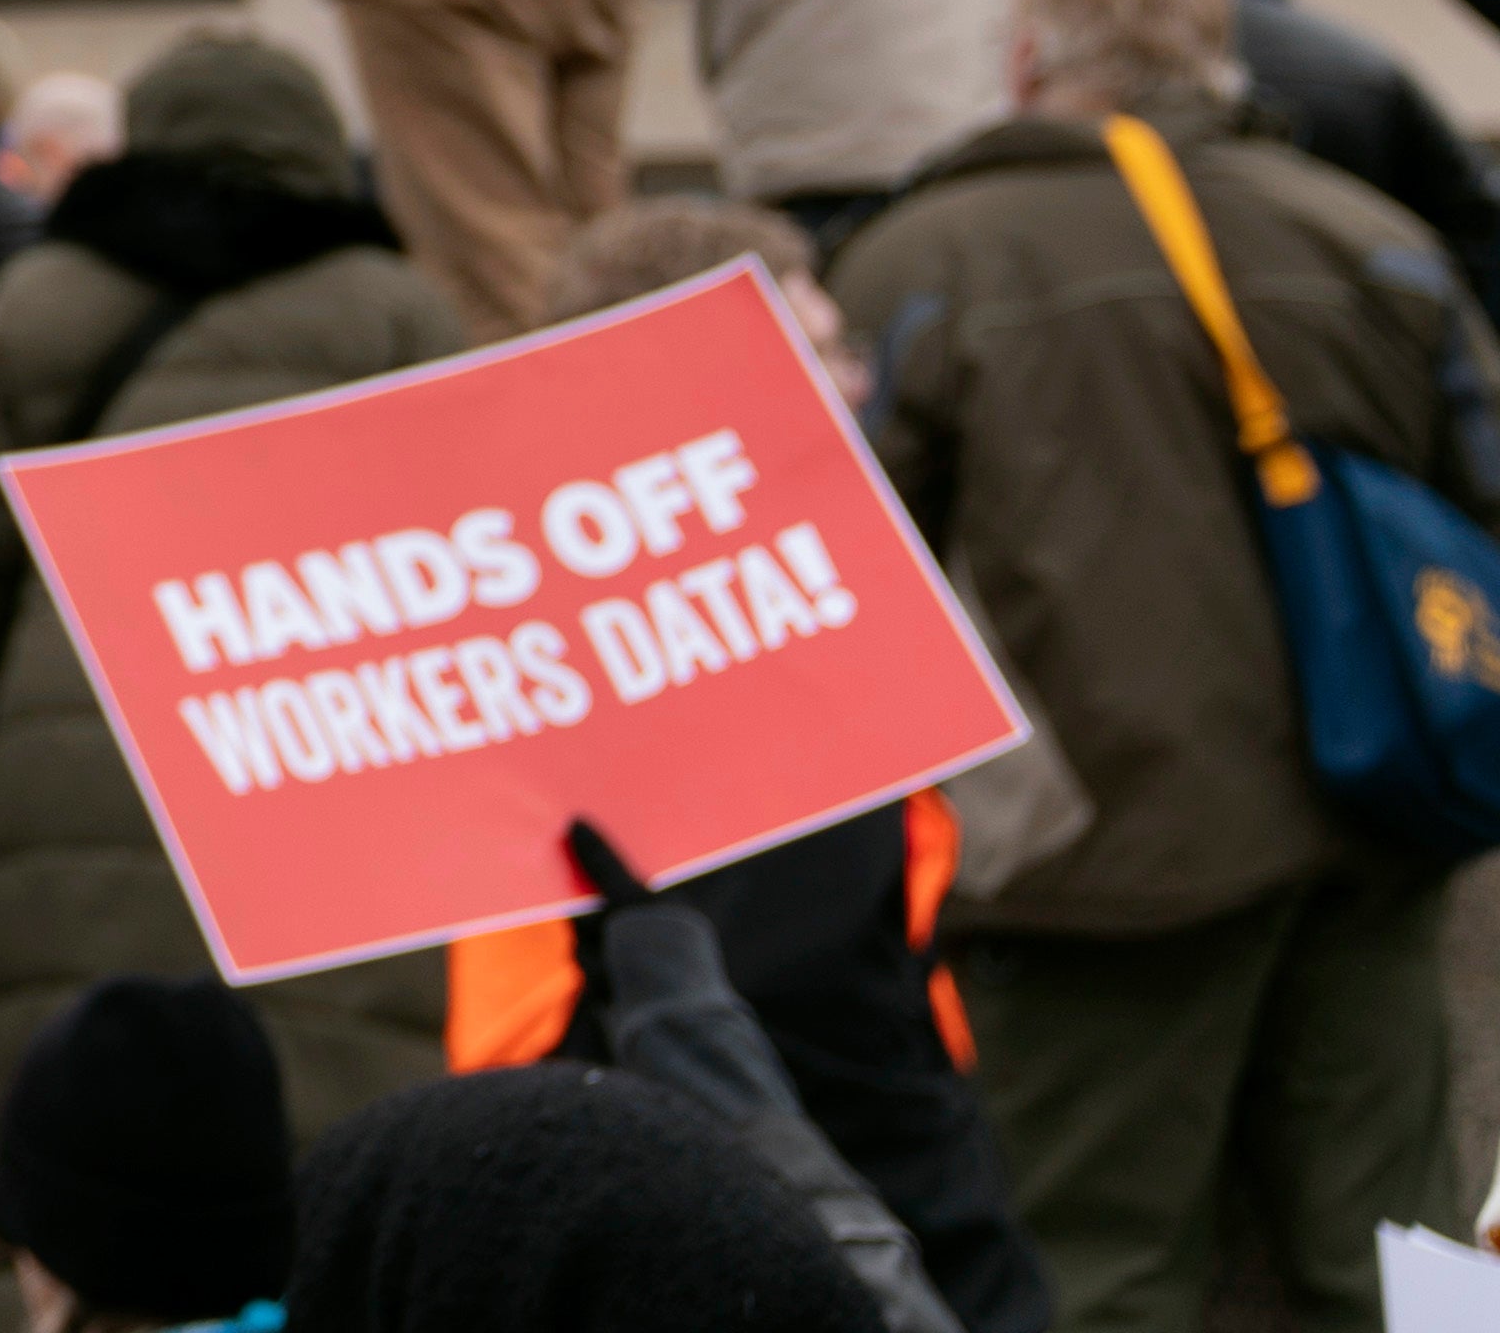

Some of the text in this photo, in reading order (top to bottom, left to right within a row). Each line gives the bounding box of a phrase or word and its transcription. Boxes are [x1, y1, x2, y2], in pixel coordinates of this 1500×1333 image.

[152, 428, 756, 674] HANDS OFF
[179, 523, 857, 795] WORKERS DATA!
